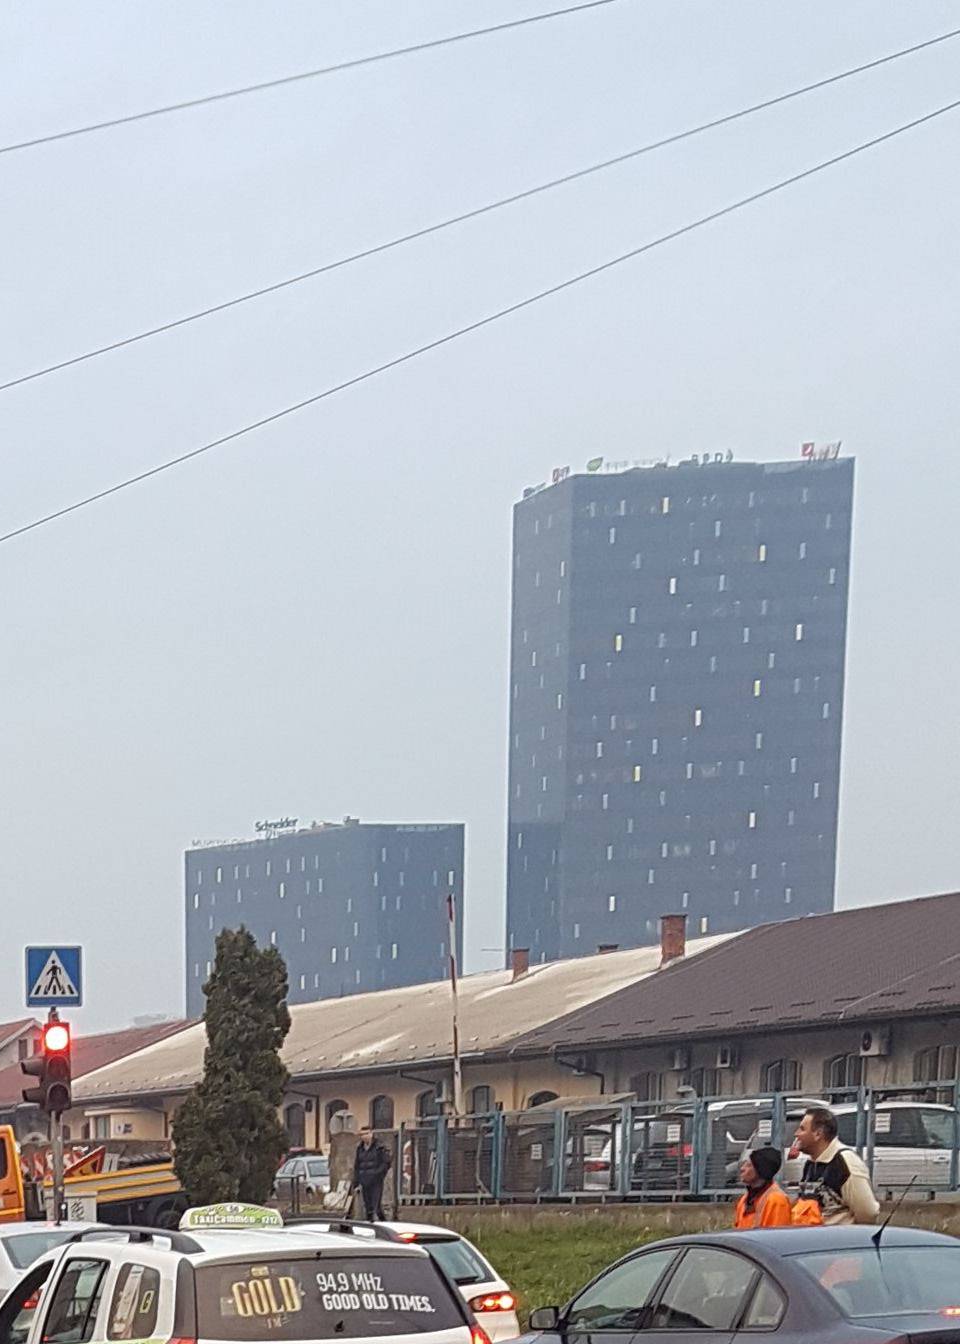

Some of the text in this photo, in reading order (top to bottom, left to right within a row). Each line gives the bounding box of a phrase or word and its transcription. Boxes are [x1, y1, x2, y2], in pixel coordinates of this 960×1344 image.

[352, 1272, 384, 1292] MHz
[231, 1276, 302, 1318] GOLD
[322, 1294, 361, 1311] GOOD
[363, 1294, 389, 1310] OLD
